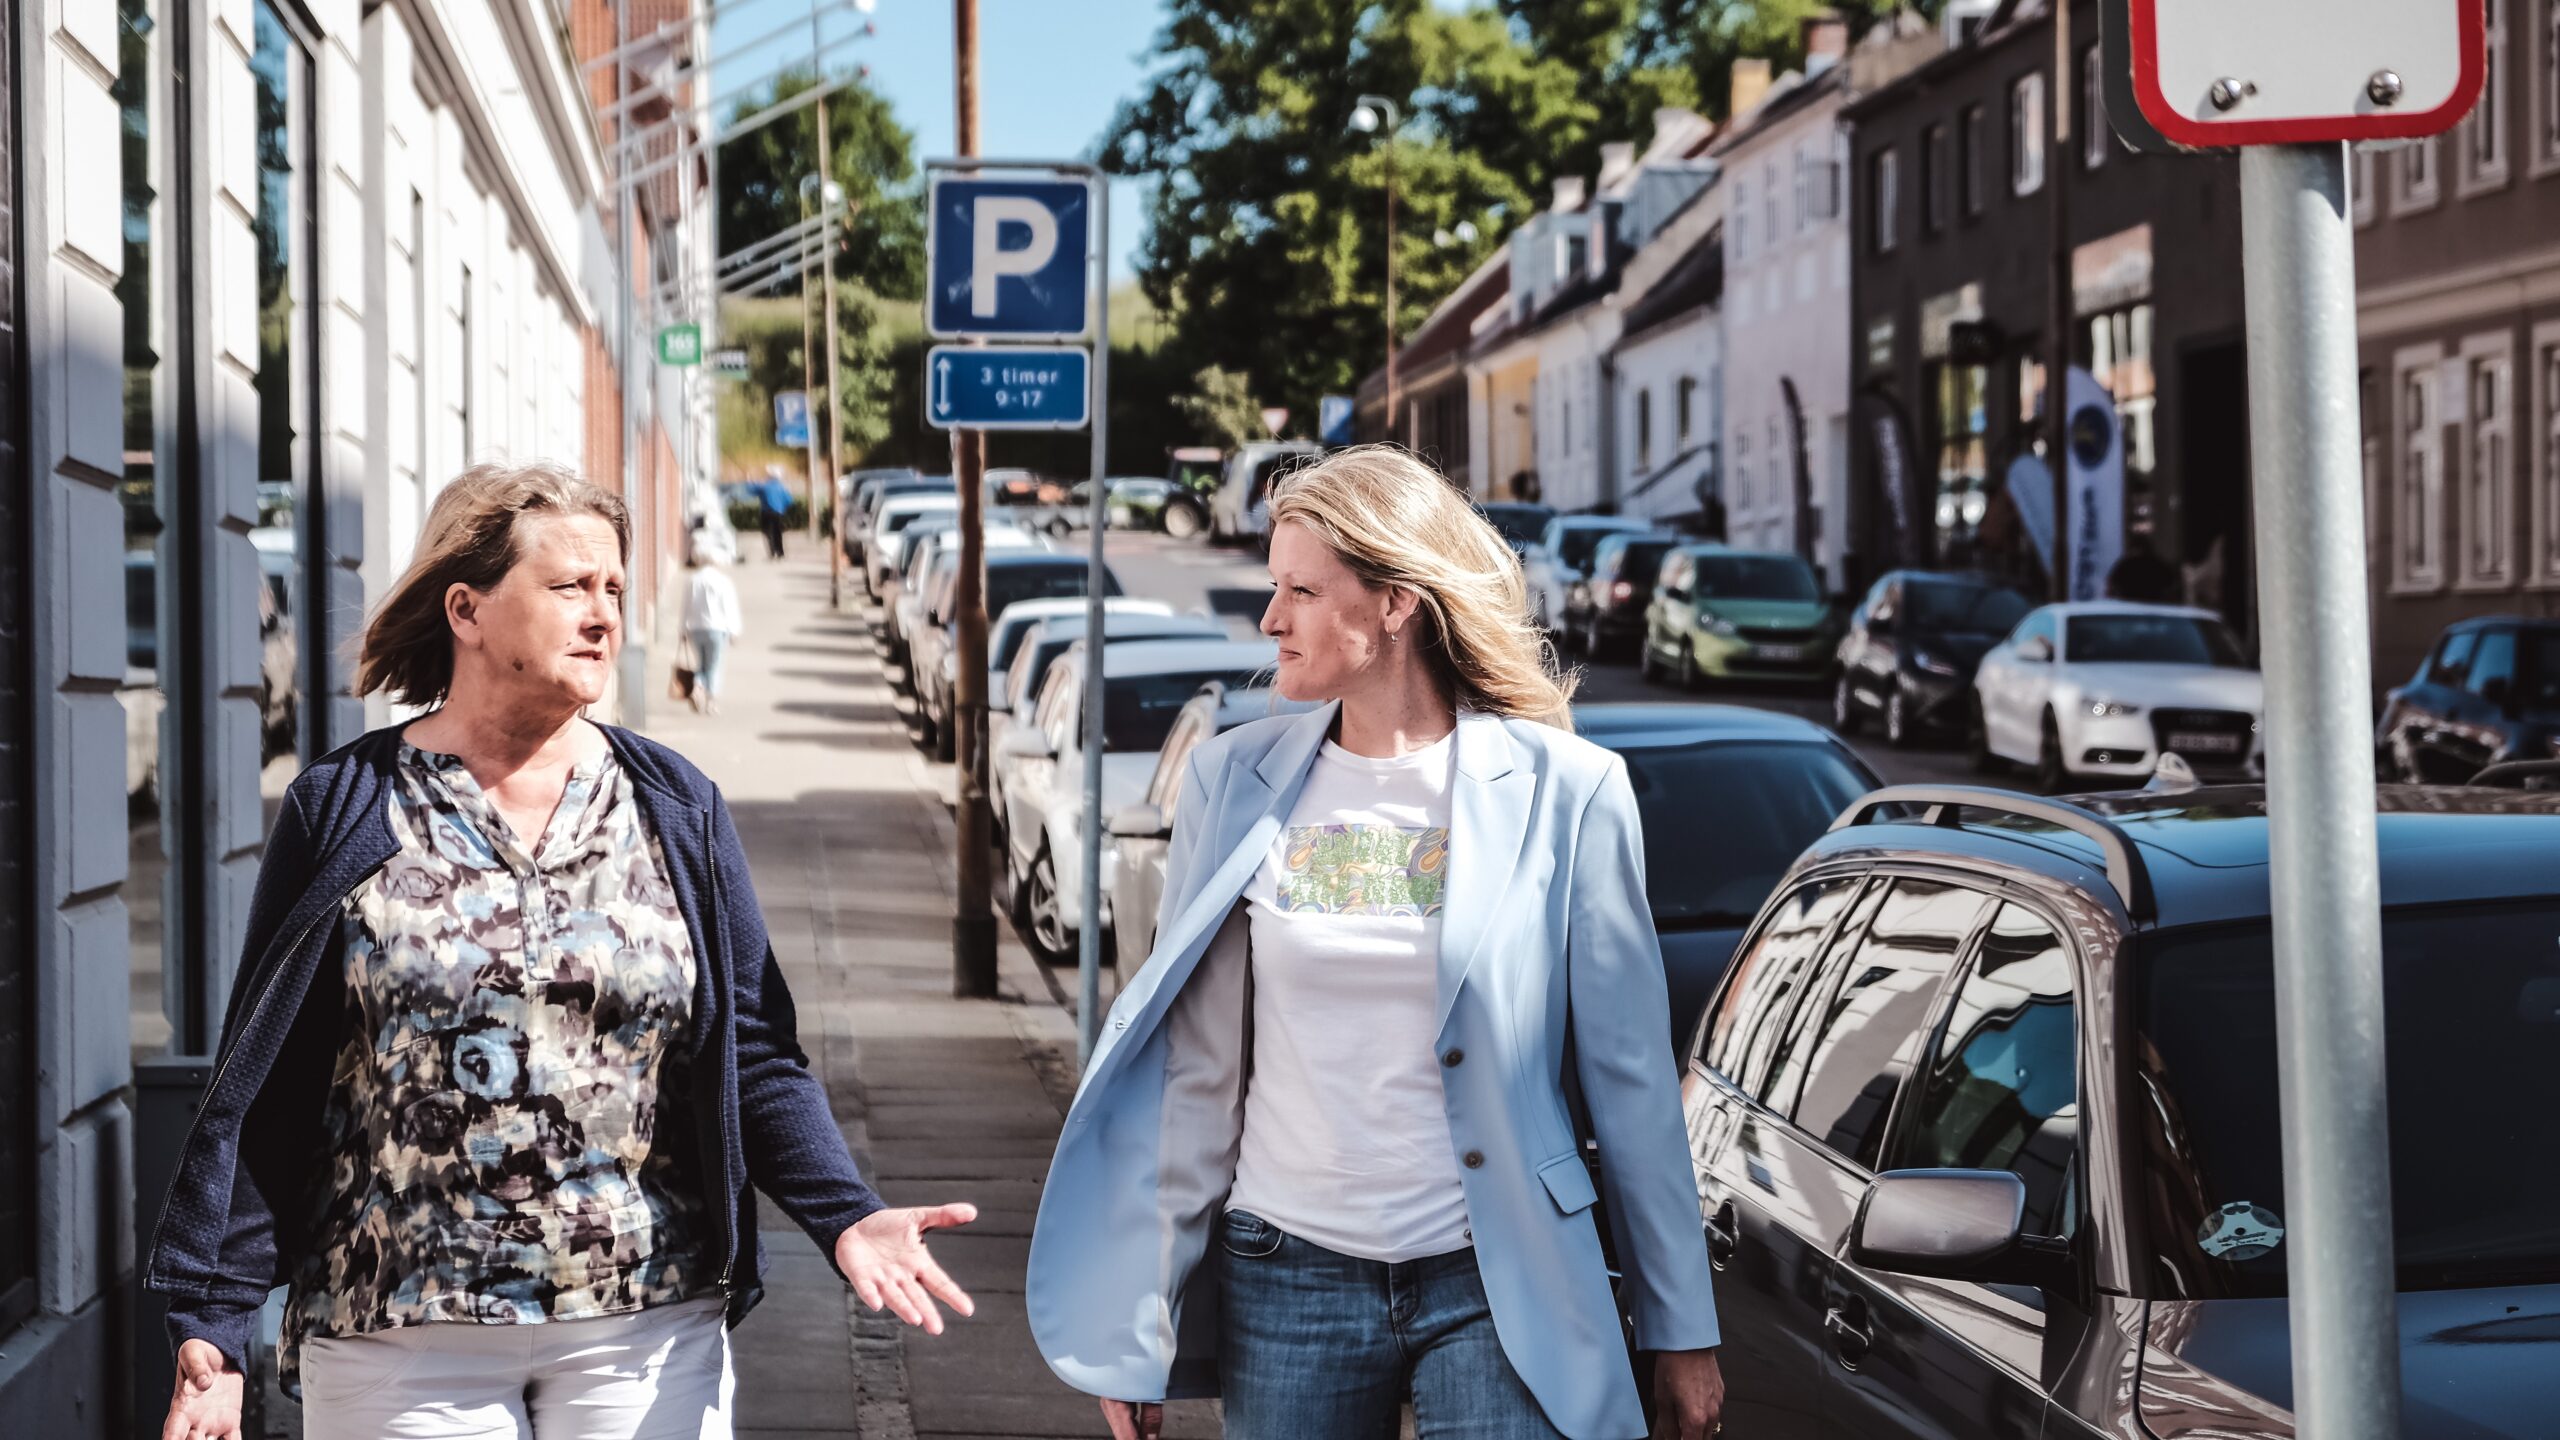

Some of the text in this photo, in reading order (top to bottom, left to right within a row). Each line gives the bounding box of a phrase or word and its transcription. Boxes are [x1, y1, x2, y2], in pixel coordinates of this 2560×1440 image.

[972, 196, 1058, 318] P
[980, 367, 1059, 385] 3 timer
[995, 390, 1043, 408] 9-17
